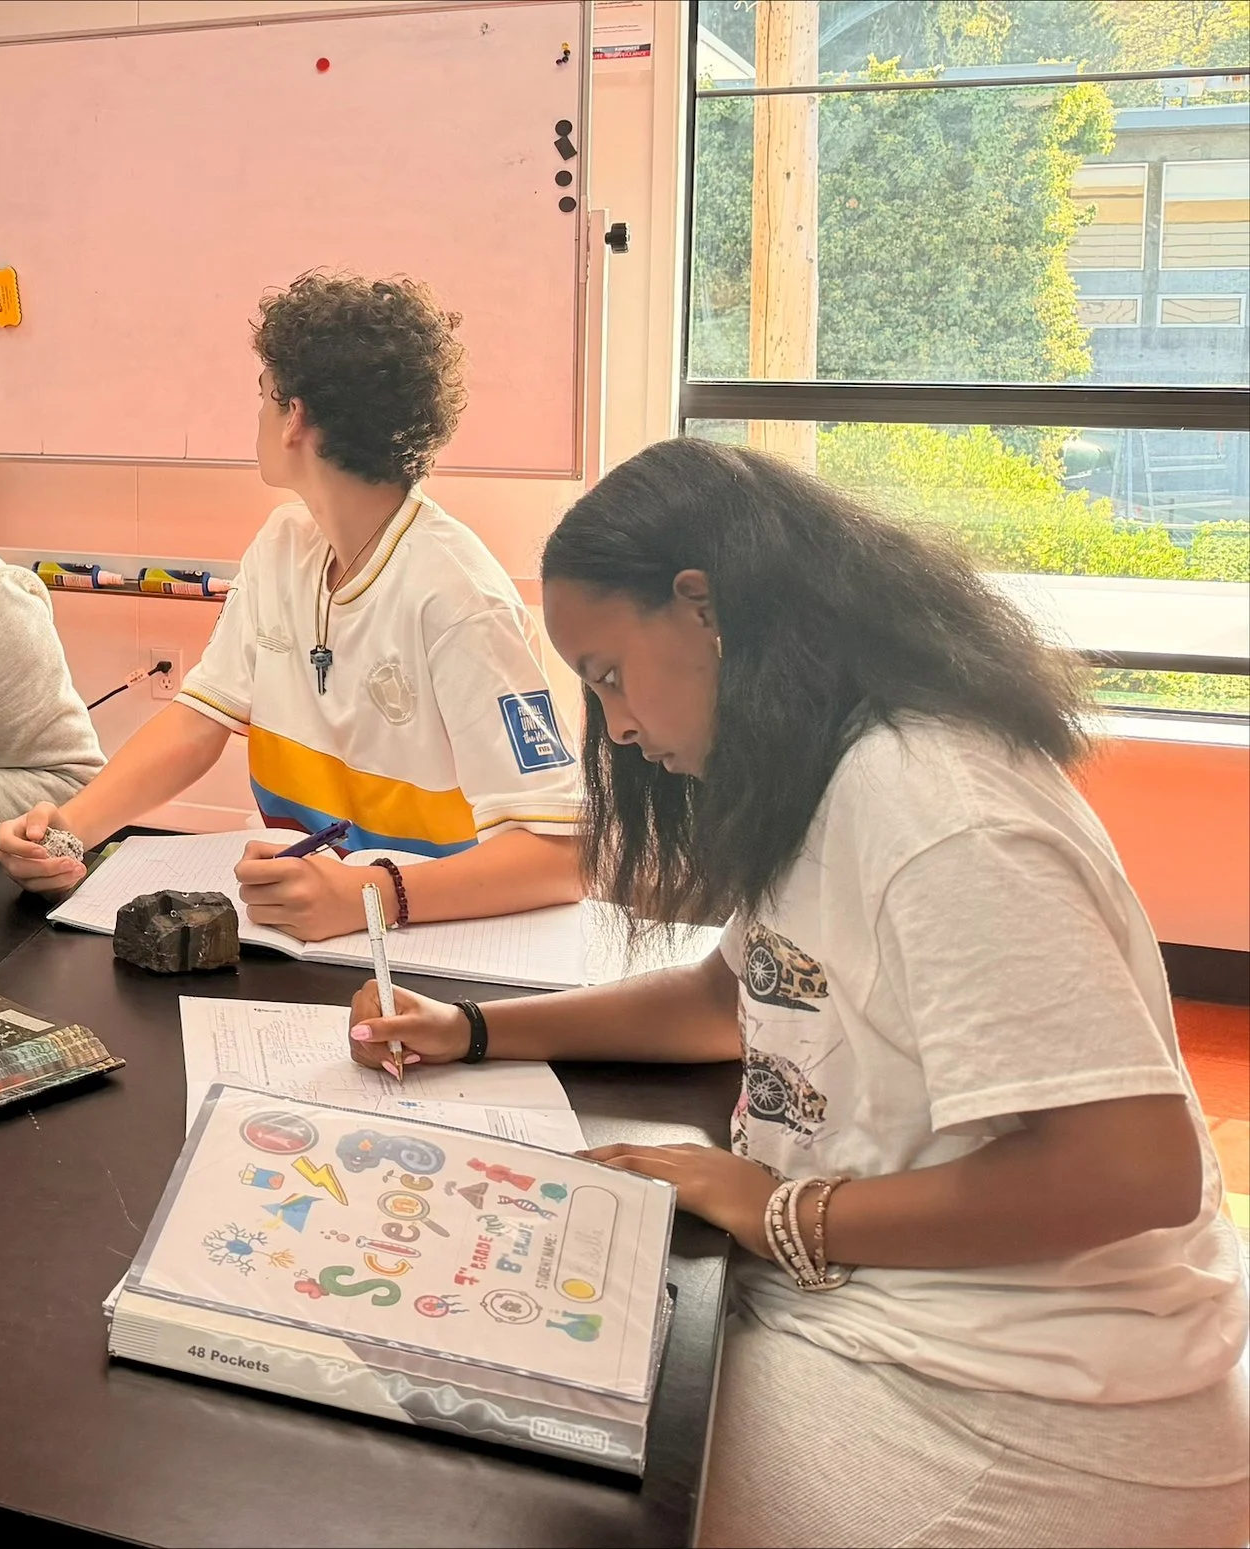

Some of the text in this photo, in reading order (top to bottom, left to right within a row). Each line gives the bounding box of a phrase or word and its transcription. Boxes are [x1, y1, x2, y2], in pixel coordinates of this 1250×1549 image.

[470, 1234, 494, 1271] GRADE
[535, 1256, 553, 1290] STUDENT
[187, 1345, 271, 1373] 48 Pockets
